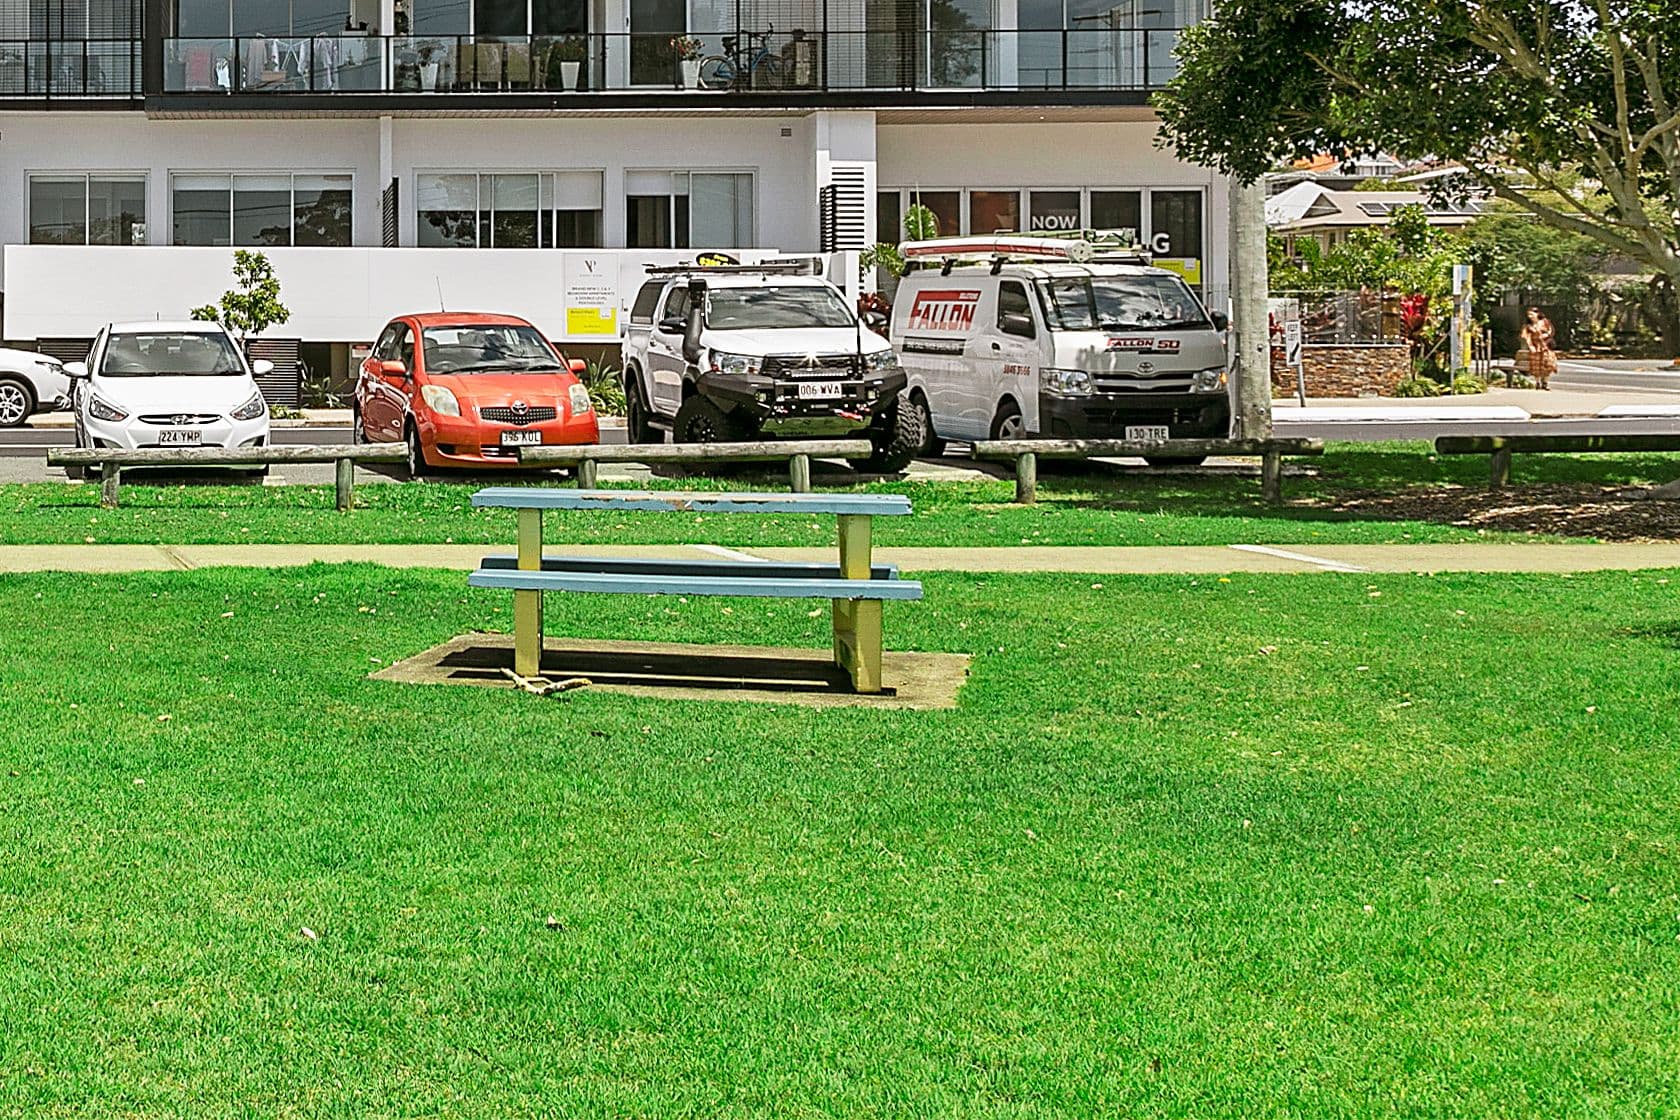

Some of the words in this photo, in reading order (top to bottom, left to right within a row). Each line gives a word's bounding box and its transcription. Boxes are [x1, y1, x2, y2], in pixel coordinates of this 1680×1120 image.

[1032, 216, 1077, 229] NOW
[908, 290, 982, 330] FALLON
[1107, 337, 1155, 347] FALLON
